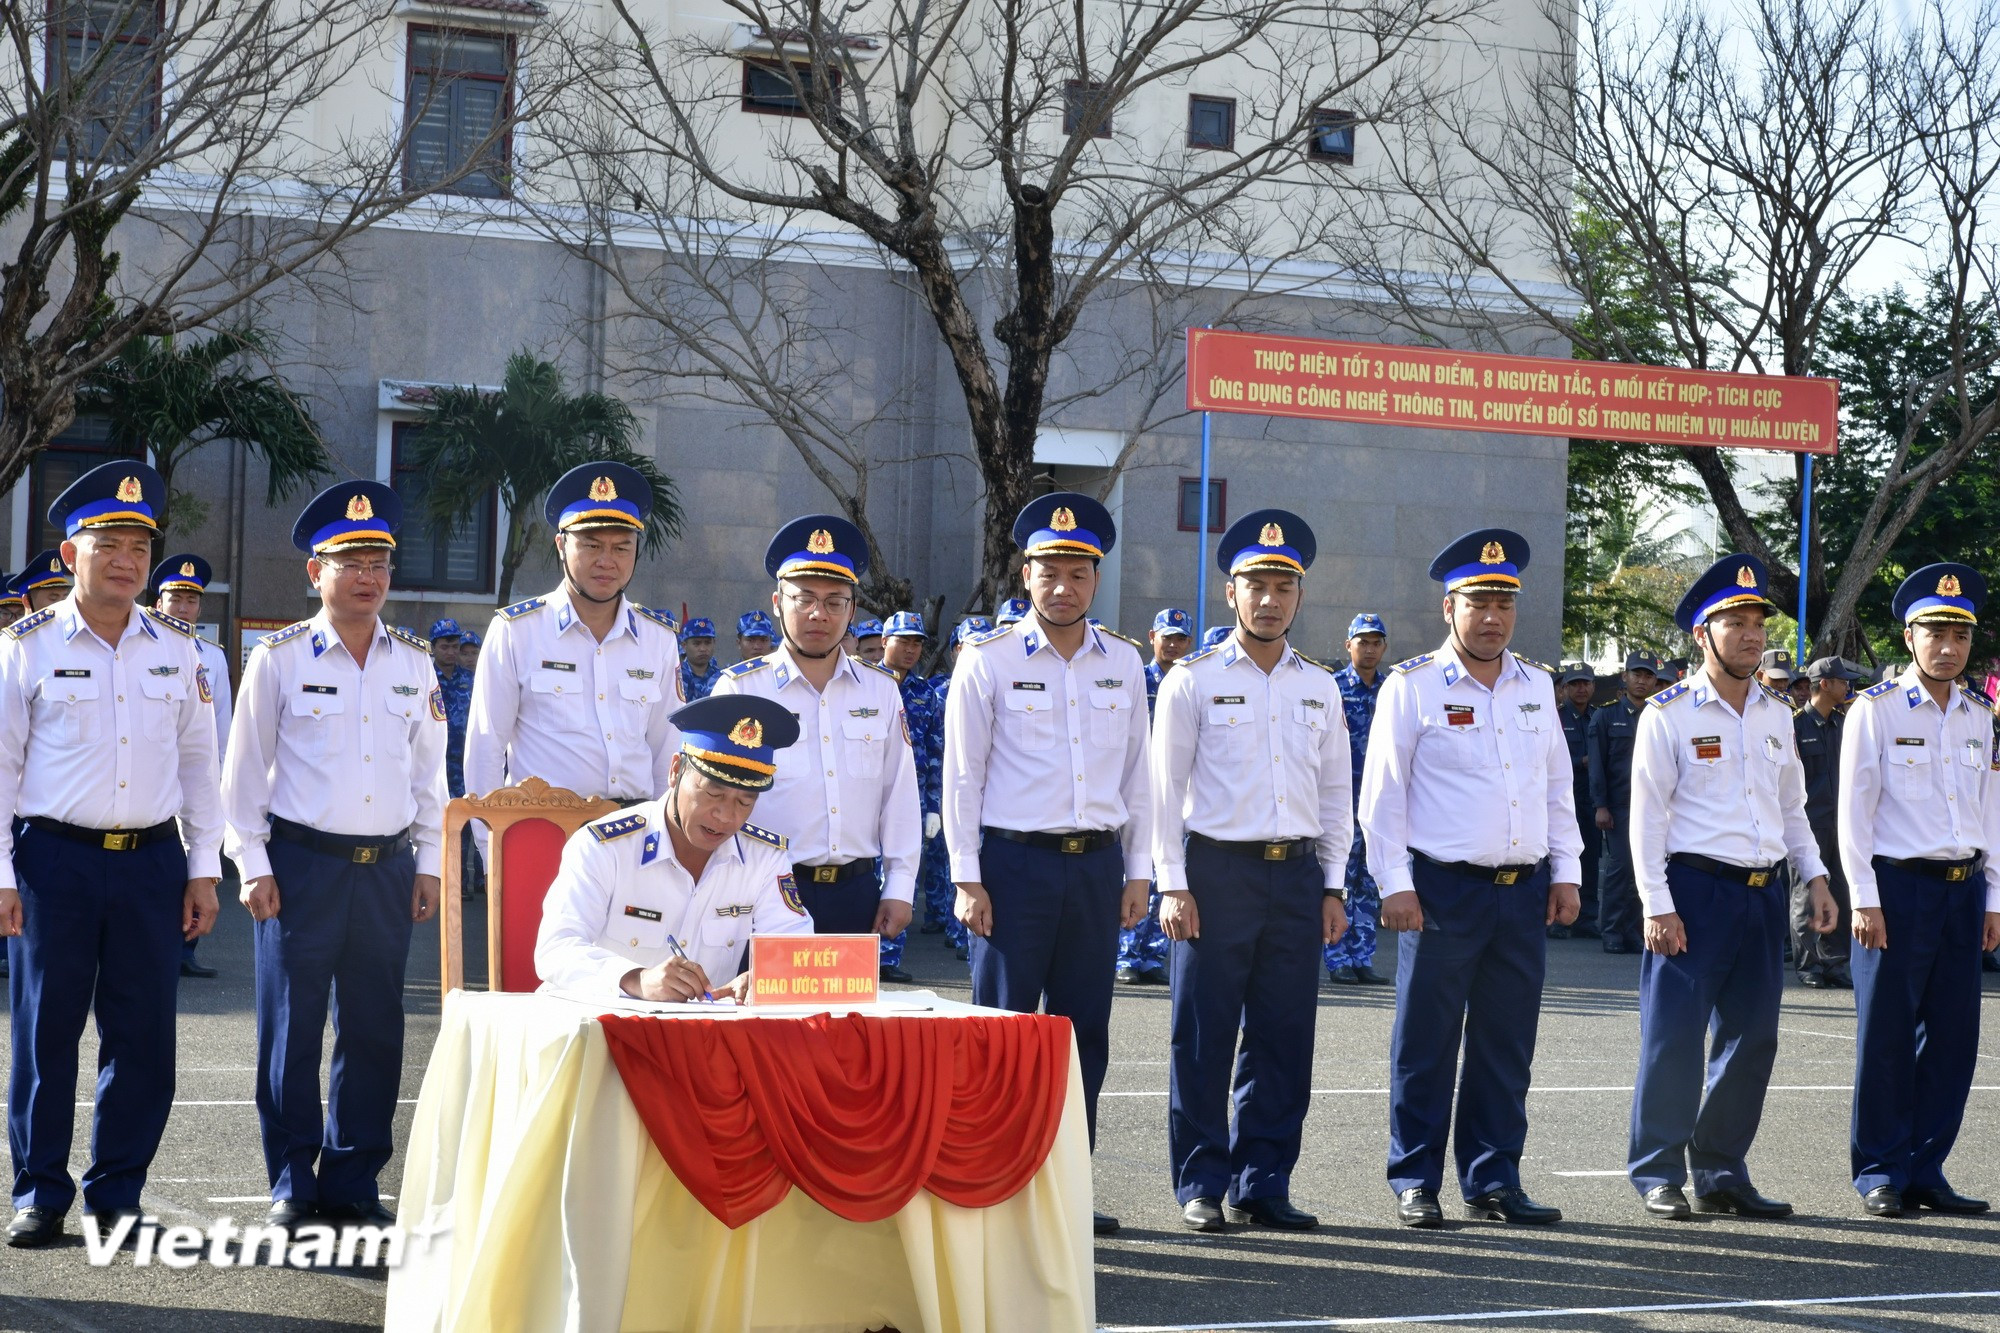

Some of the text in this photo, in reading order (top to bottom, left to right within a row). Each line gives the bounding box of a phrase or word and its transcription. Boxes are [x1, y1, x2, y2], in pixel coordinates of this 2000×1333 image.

[1254, 350, 1781, 411] THỰC HIỆN TỐT 3 QUAN ĐIỂM, 8 NGUYÊN TẮC, 6 MỐI KẾT HỢP; TÍCH CỰC
[1210, 376, 1819, 444] ỨNG DỤNG CÔNG NGHỆ THÔNG TIN, CHUYỂN ĐỔI SỐ TRONG NHIỆM VỤ HUẤN LUYỆN
[793, 946, 839, 967] KÝ KẾT
[756, 975, 873, 995] GIAO ƯỚC THI ĐUA
